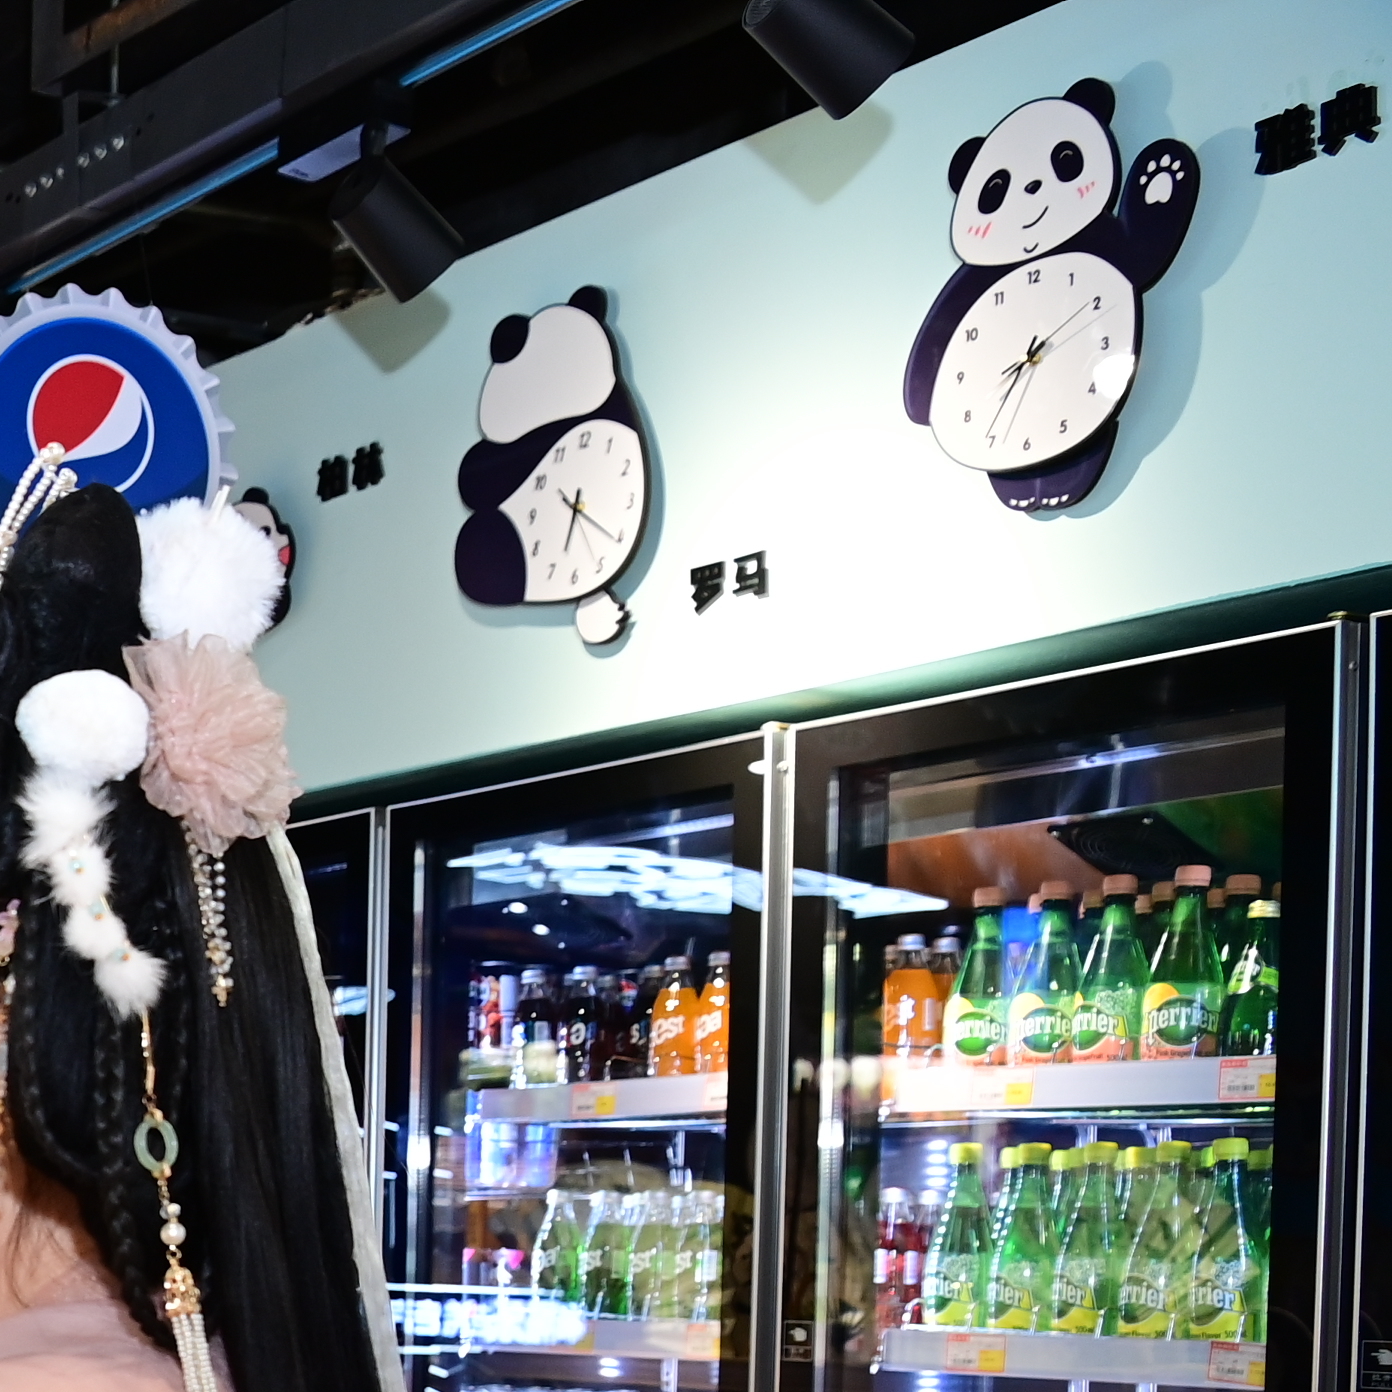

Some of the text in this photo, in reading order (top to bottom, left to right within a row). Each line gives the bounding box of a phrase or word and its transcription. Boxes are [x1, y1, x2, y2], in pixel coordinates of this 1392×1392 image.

[1027, 269, 1041, 285] 12
[1068, 273, 1075, 286] 1
[994, 292, 1005, 306] 11
[1092, 296, 1101, 310] 2
[965, 328, 979, 342] 10
[1101, 336, 1109, 351] 3
[956, 371, 964, 385] 9
[1088, 382, 1096, 395] 4
[964, 410, 972, 424] 8
[1059, 420, 1068, 434] 5
[578, 431, 591, 449] 12
[605, 437, 613, 454] 1
[1022, 438, 1031, 451] 6
[554, 446, 565, 463] 11
[621, 459, 631, 476] 2
[535, 474, 547, 491] 10
[626, 493, 635, 509] 3
[528, 509, 537, 525] 9
[532, 541, 541, 556] 8
[548, 563, 557, 579] 7
[596, 556, 605, 574] 5
[570, 568, 579, 585] 6
[690, 551, 769, 615] 罗马
